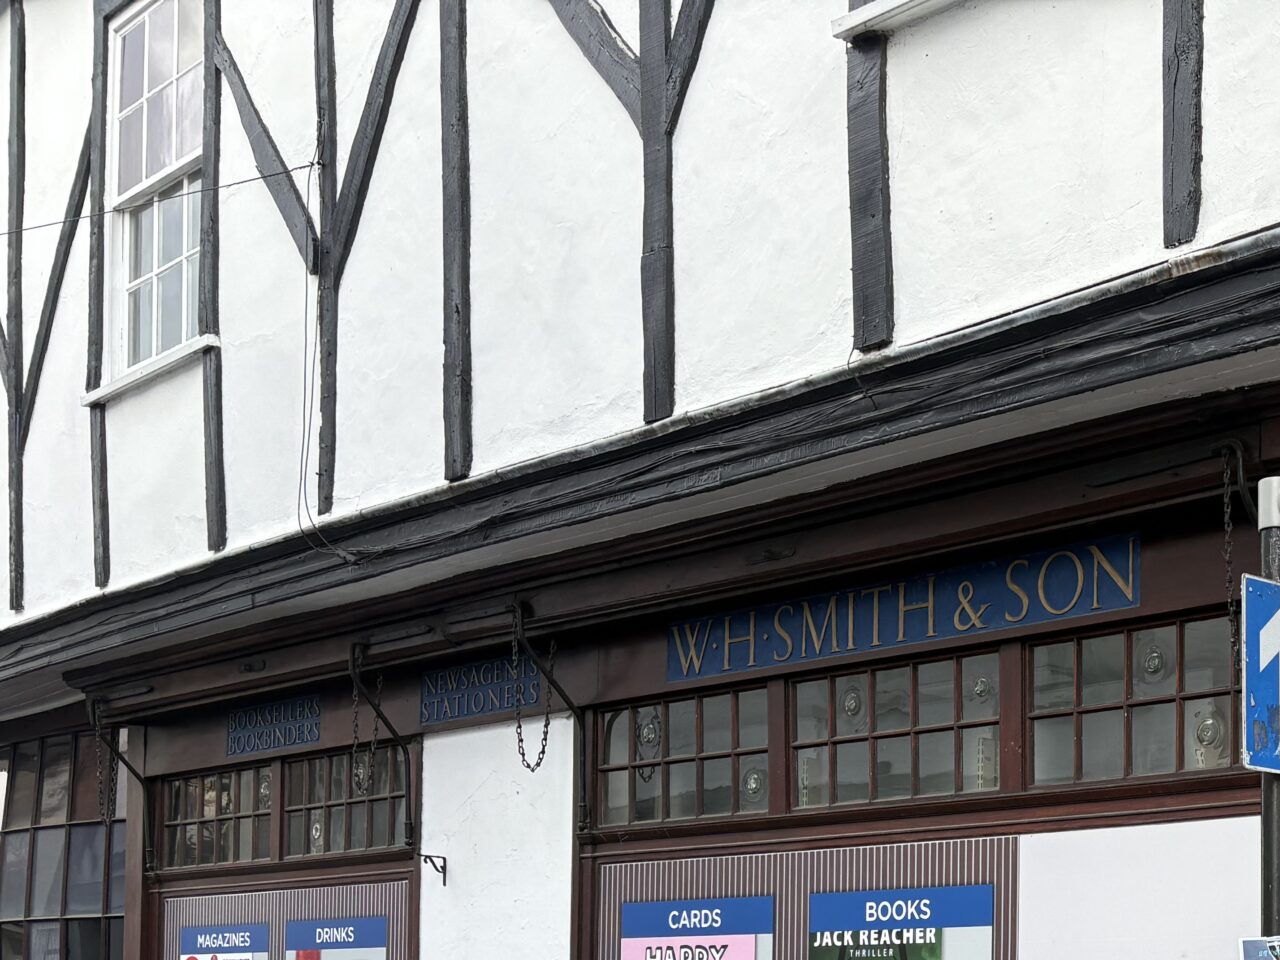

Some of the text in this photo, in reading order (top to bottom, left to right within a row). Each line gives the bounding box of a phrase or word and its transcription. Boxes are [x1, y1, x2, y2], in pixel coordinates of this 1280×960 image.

[953, 581, 991, 632] &
[1005, 536, 1136, 622] SON
[424, 656, 537, 696] NEWSAGENTS
[422, 681, 539, 722] STATIONERS
[228, 698, 320, 733] BOOKSELLERS
[227, 722, 319, 755] BOOKBINDERS
[668, 909, 722, 929] CARDS
[865, 899, 931, 922] BOOKS
[197, 932, 251, 948] MAGAZINES
[315, 927, 355, 944] DRINKS
[813, 927, 937, 947] JACK REACHER
[850, 949, 894, 958] THRILLER
